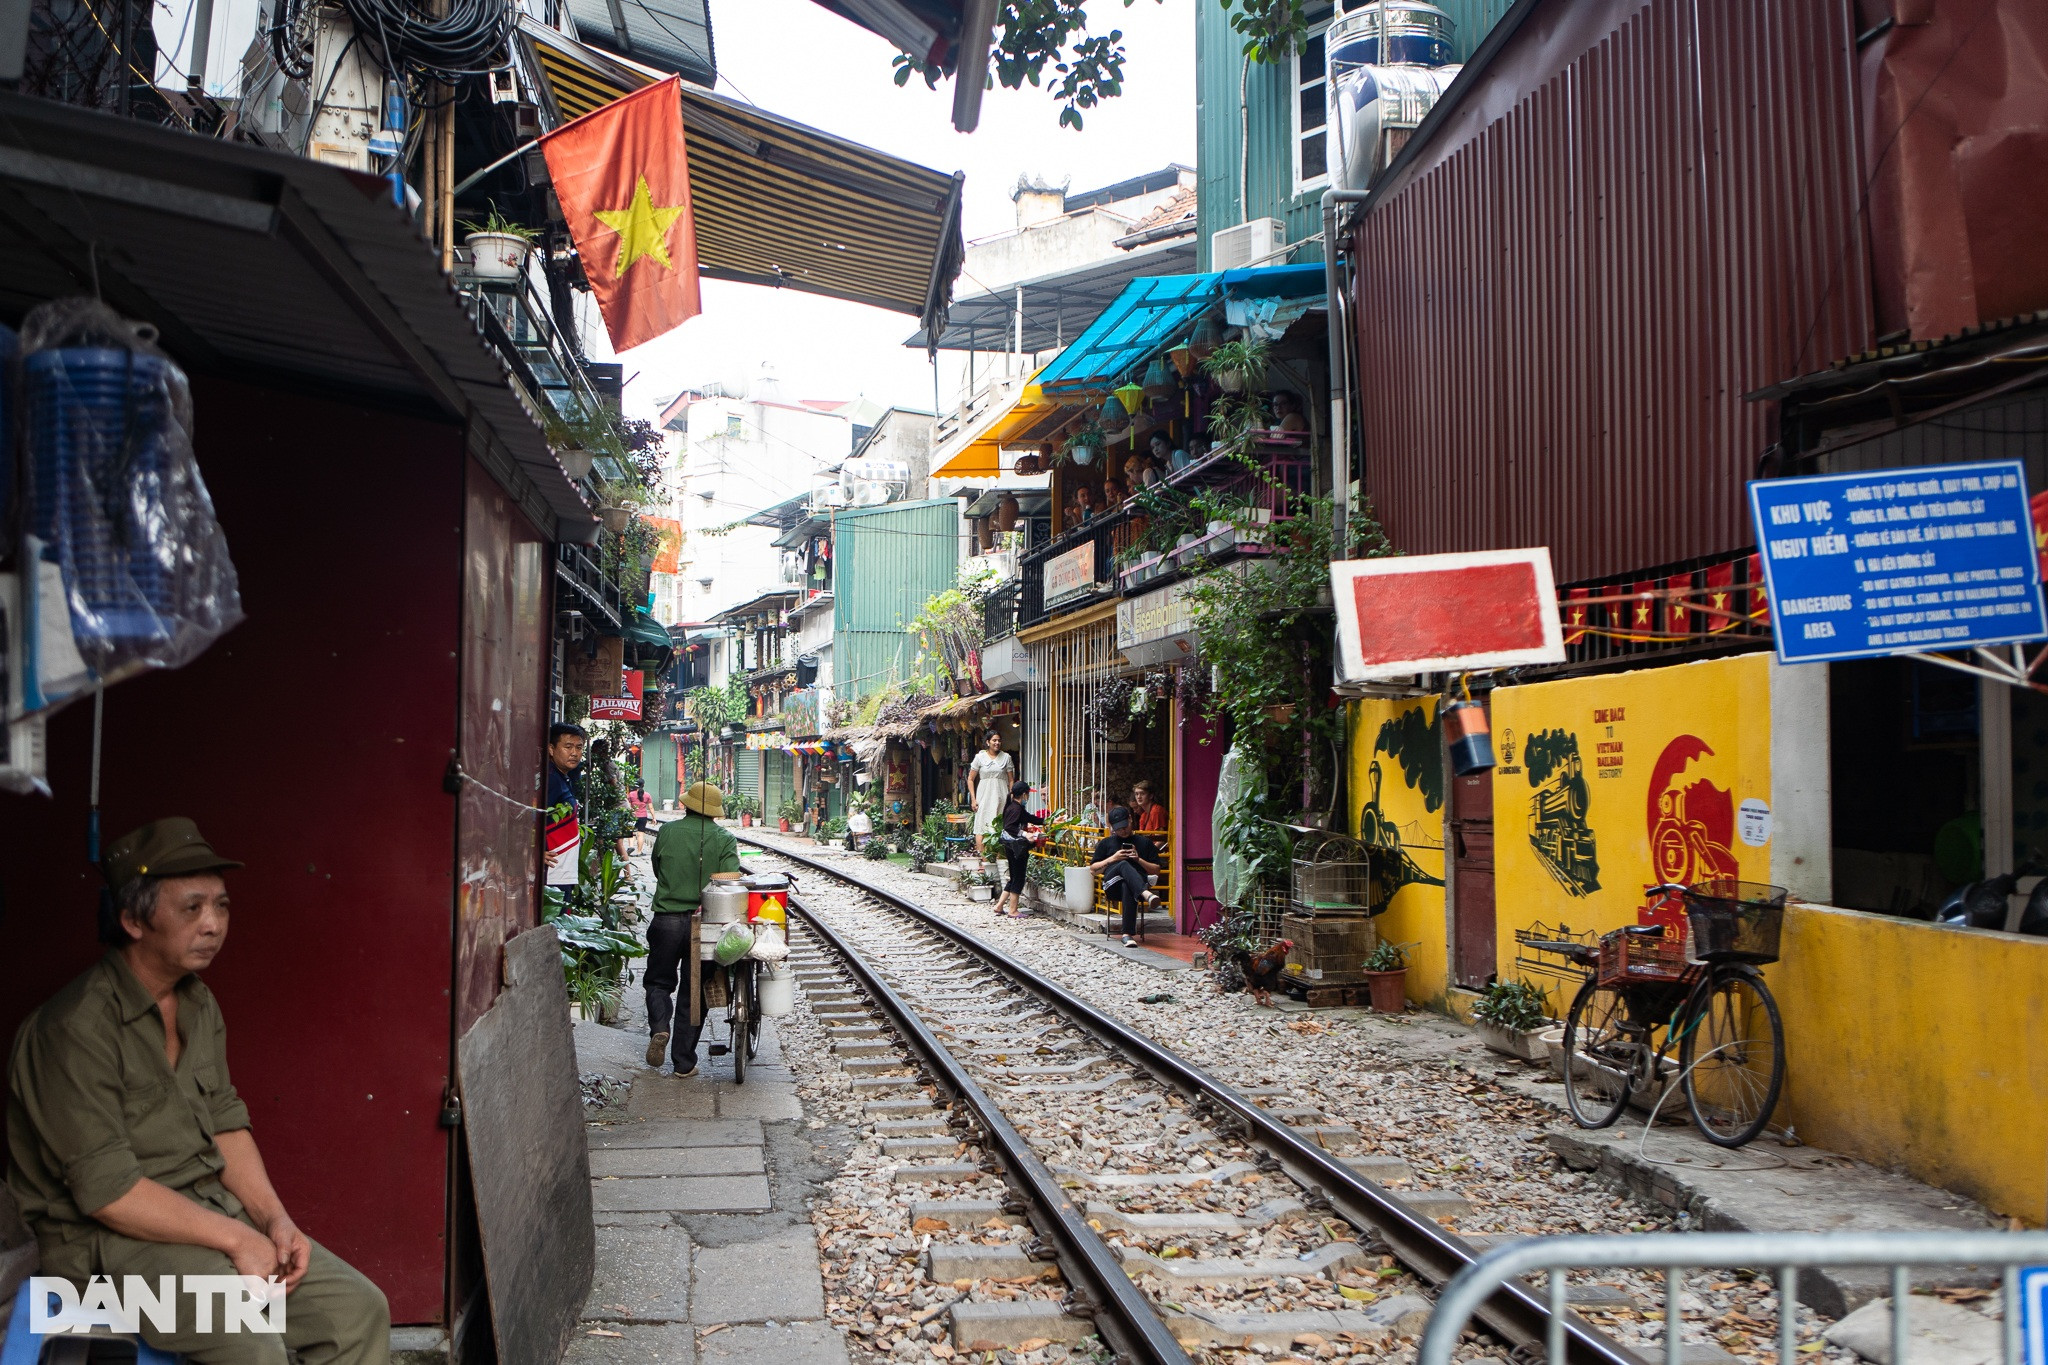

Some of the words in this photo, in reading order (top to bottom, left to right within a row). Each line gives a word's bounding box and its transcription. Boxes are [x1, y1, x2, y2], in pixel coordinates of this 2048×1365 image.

[1770, 504, 1801, 525] KHU
[1803, 500, 1832, 526] VỰC
[1770, 538, 1808, 560] NGUY
[1811, 527, 1849, 556] HIỂM
[1781, 594, 1853, 616] DANGEROUS
[1804, 621, 1836, 639] AREA
[593, 700, 640, 711] RAILWAY
[1594, 709, 1608, 724] COME
[1610, 707, 1625, 722] BACK
[1606, 726, 1613, 738] TO
[1597, 742, 1623, 754] VIETNAM
[1598, 756, 1623, 767] RAILROAD
[1599, 768, 1622, 778] HISTORY
